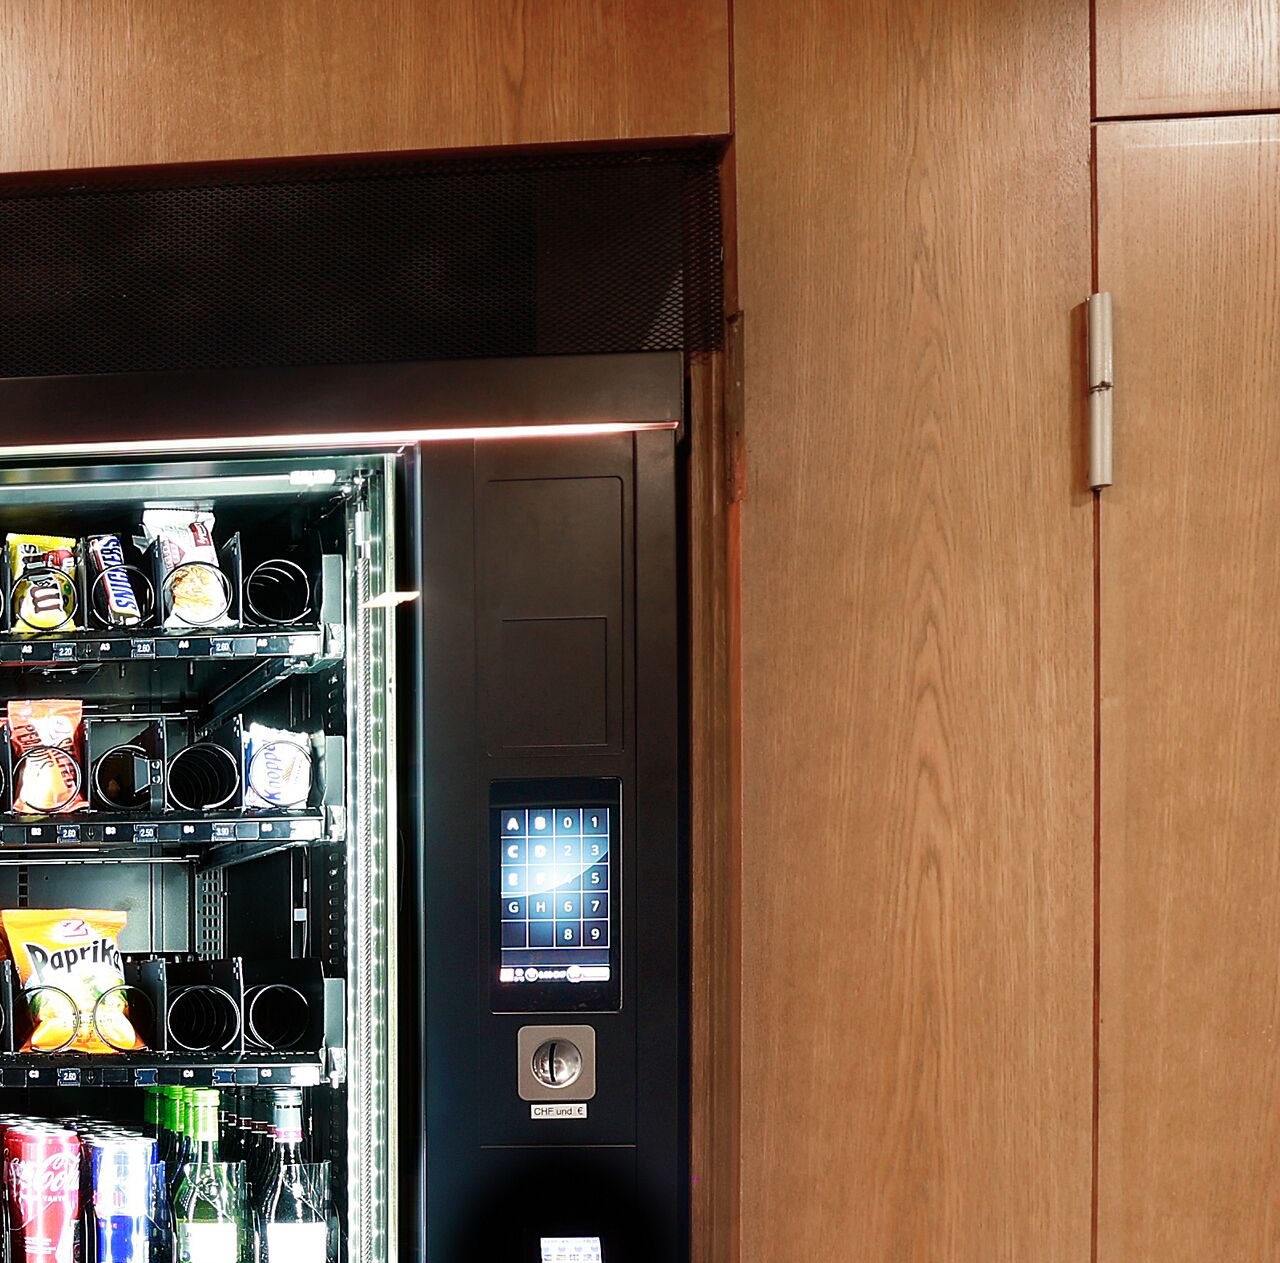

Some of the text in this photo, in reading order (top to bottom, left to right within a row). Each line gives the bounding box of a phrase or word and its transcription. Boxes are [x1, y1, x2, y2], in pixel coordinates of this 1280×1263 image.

[507, 817, 519, 830] A
[563, 816, 572, 828] 0
[591, 816, 598, 828] 1
[508, 845, 518, 858] C
[564, 845, 572, 856] 2
[591, 844, 600, 856] 3
[591, 872, 600, 884] 5
[508, 900, 600, 912] G H 6 7
[564, 928, 600, 940] 8 9
[534, 1106, 584, 1116] CHF und €
